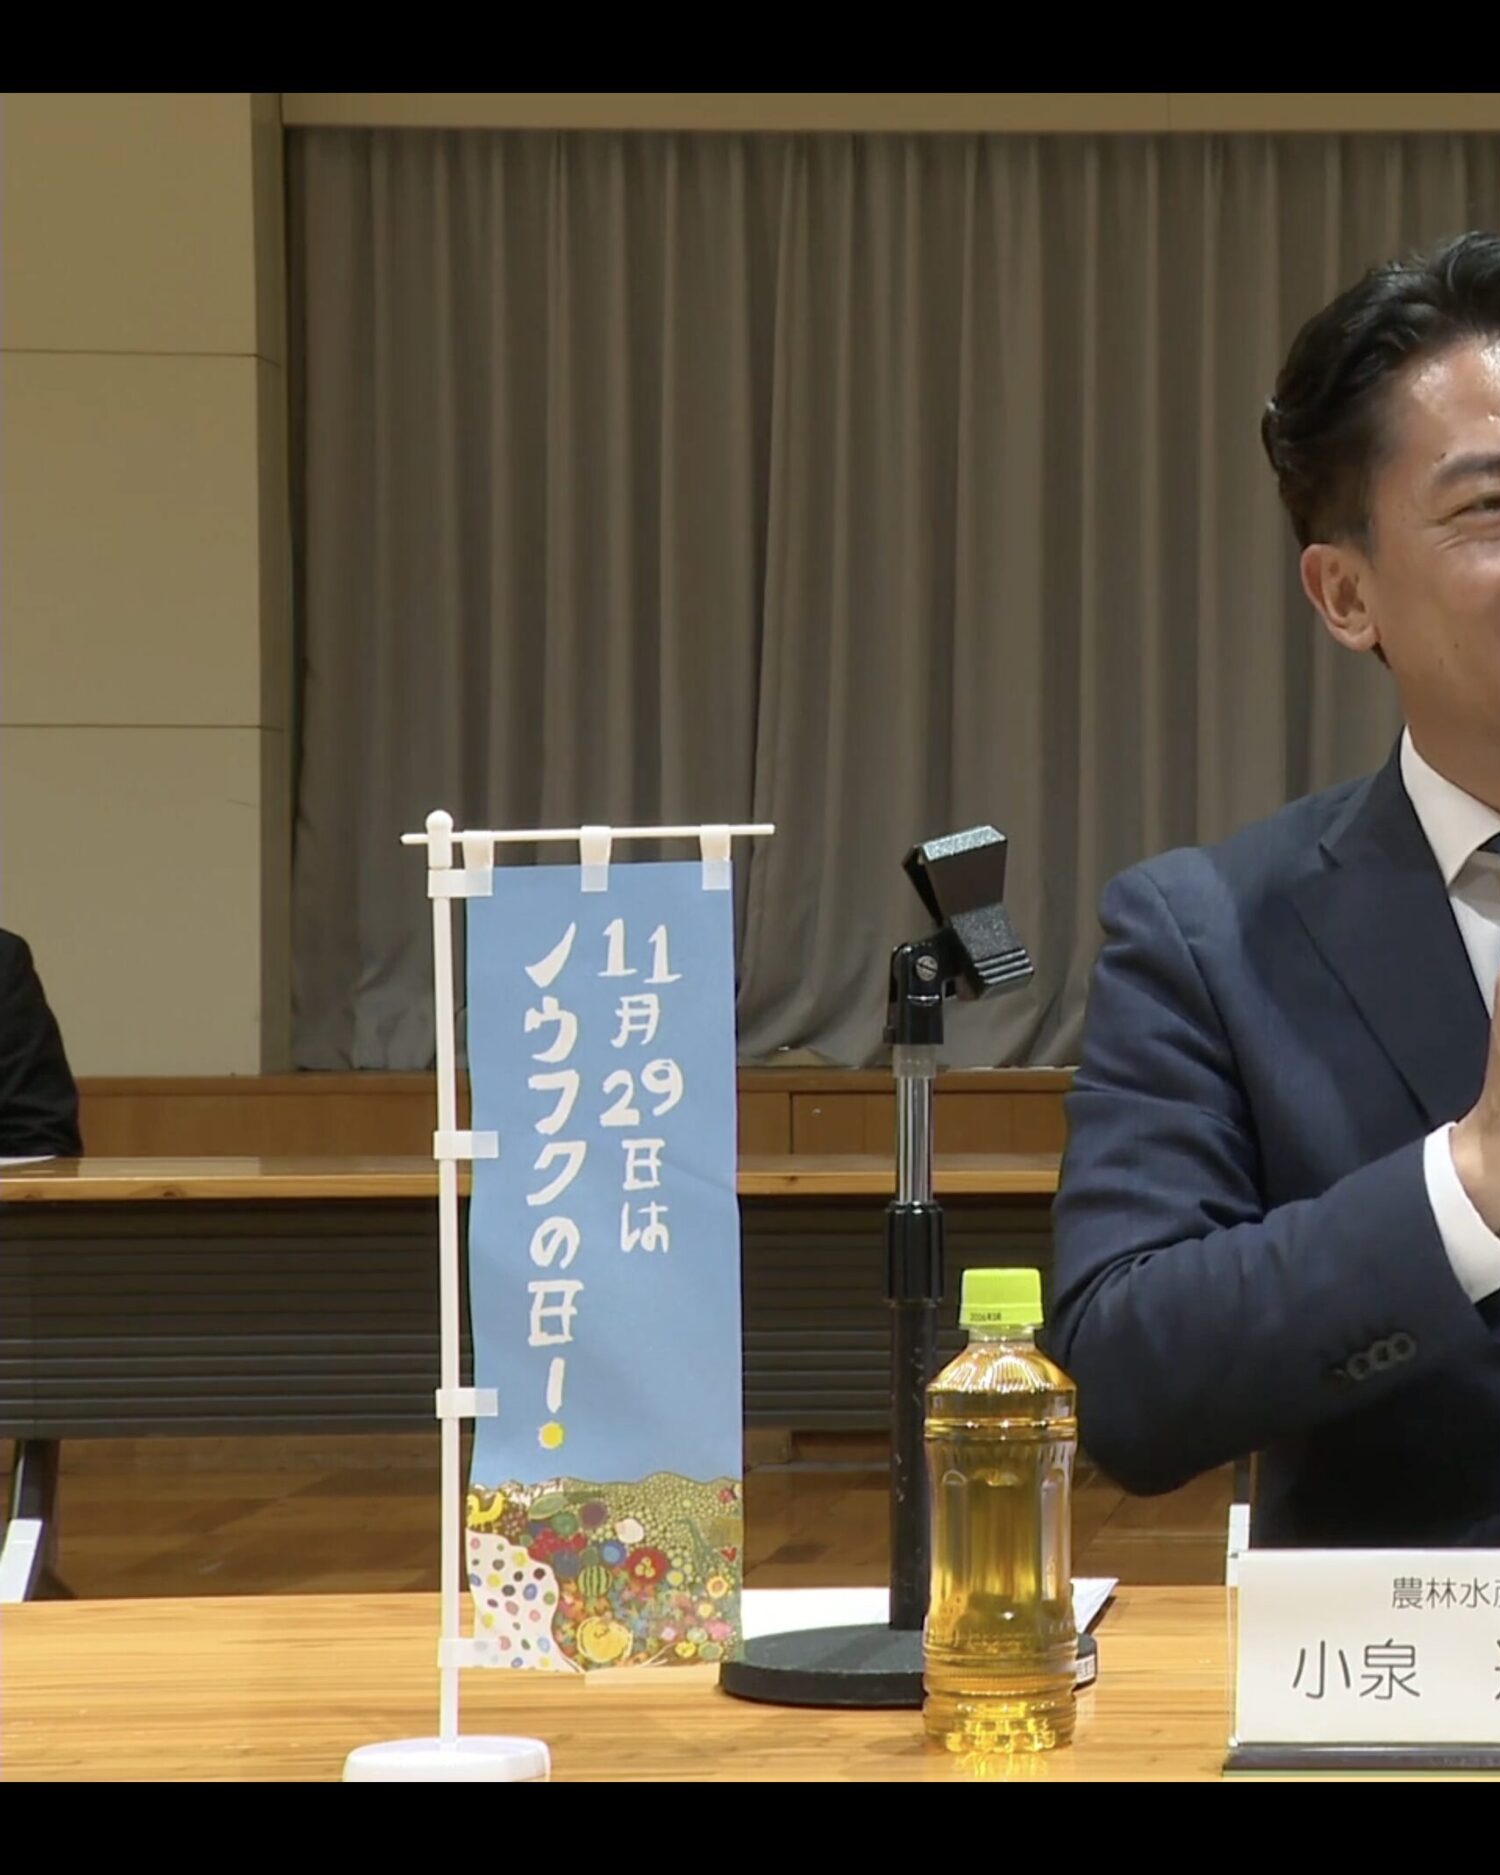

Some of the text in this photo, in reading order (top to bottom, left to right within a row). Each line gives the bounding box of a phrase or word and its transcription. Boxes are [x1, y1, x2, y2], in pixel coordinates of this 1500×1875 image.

[598, 917, 684, 1254] 11月29日は
[1292, 1638, 1420, 1700] 小泉
